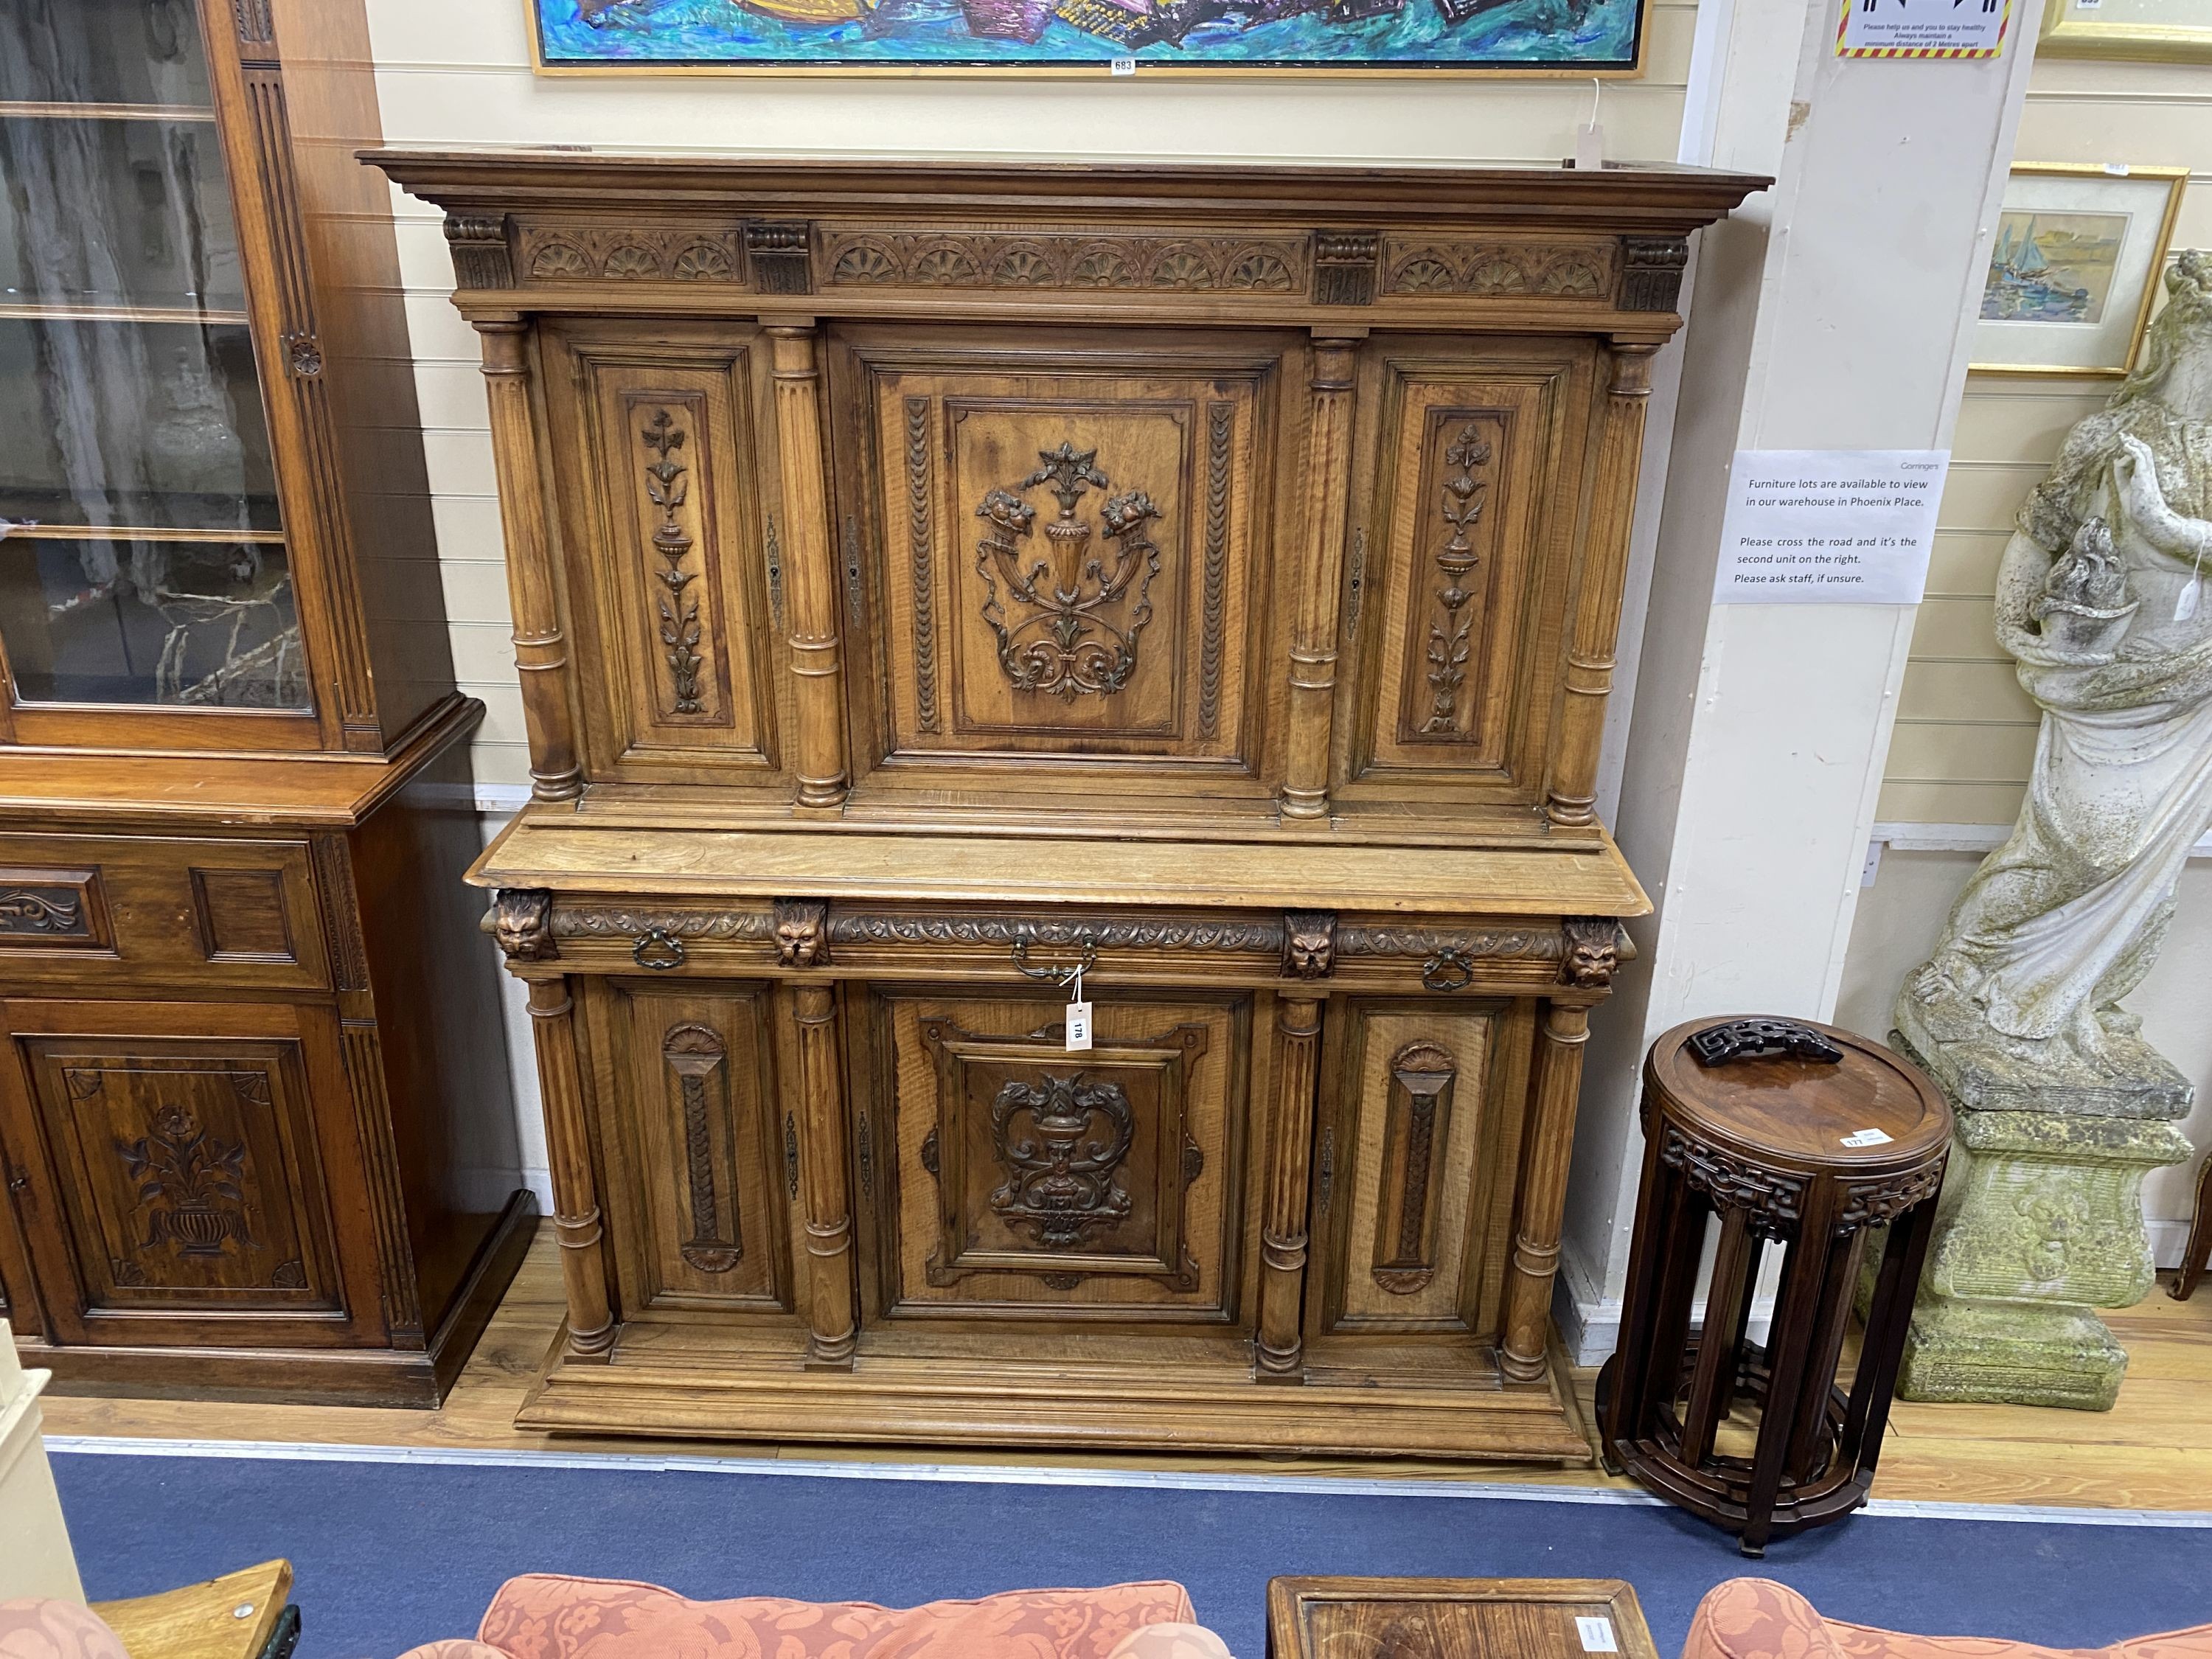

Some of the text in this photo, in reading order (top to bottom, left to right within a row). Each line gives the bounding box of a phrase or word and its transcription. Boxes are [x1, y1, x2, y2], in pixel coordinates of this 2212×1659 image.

[1116, 61, 1132, 70] 683
[1749, 479, 1796, 488] Furniture
[1799, 479, 1818, 488] lots
[1840, 479, 1886, 488] available
[1904, 480, 1928, 488] view
[1746, 497, 1756, 506] in
[1779, 497, 1834, 506] warehouse
[1837, 497, 1847, 506] in
[1850, 497, 1891, 507] Phoenix
[1894, 497, 1924, 507] Place.
[1740, 538, 1773, 546] Please
[1808, 538, 1825, 546] the
[1829, 538, 1853, 546] road
[1857, 538, 1877, 546] and
[1900, 538, 1917, 546] the
[1737, 554, 1773, 563] second
[1775, 554, 1796, 563] unit
[1815, 554, 1832, 563] the
[1834, 554, 1861, 566] right.
[1734, 574, 1767, 582] Please
[1770, 574, 1786, 582] ask
[1789, 574, 1814, 584] staff,
[1817, 574, 1826, 582] if
[1074, 1023, 1083, 1039] 178
